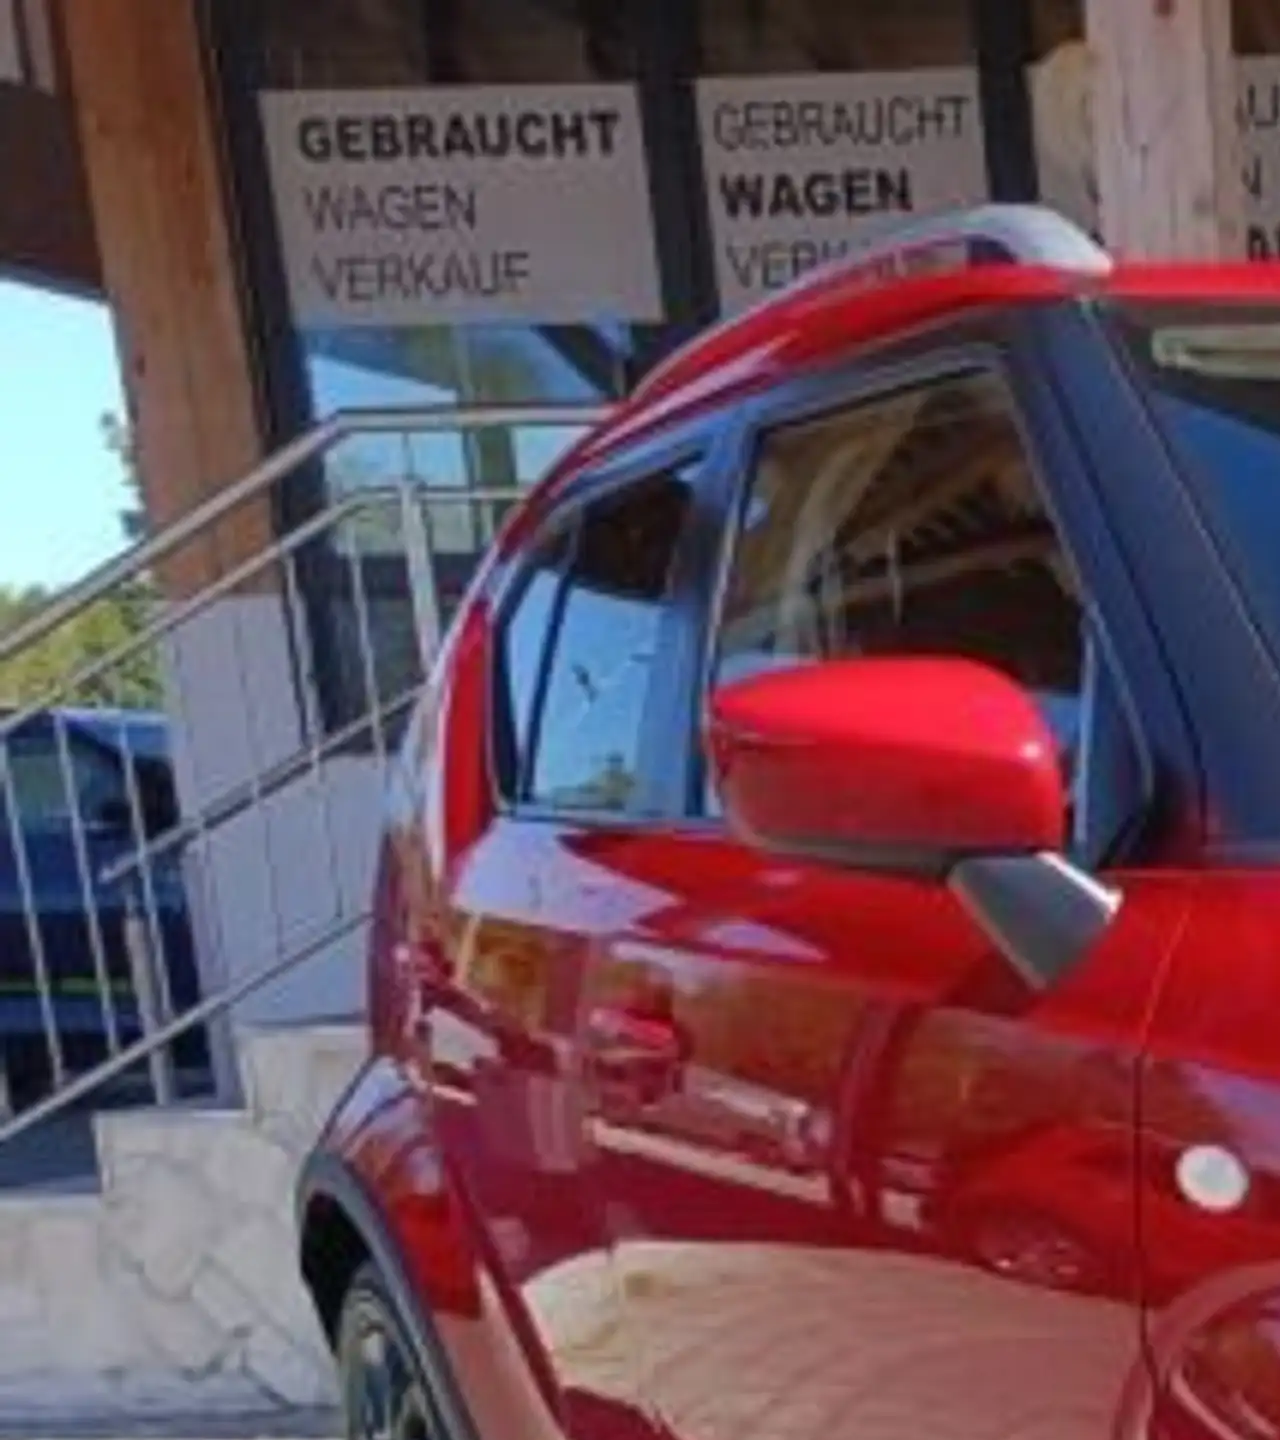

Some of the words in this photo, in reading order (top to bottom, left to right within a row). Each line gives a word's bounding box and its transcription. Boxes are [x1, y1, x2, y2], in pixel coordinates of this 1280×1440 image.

[298, 110, 620, 162] GEBRAUCHT
[713, 96, 969, 151] GEBRAUCHT
[304, 183, 477, 232] WAGEN
[719, 166, 913, 218] WAGEN
[310, 250, 531, 302] VERKAUF
